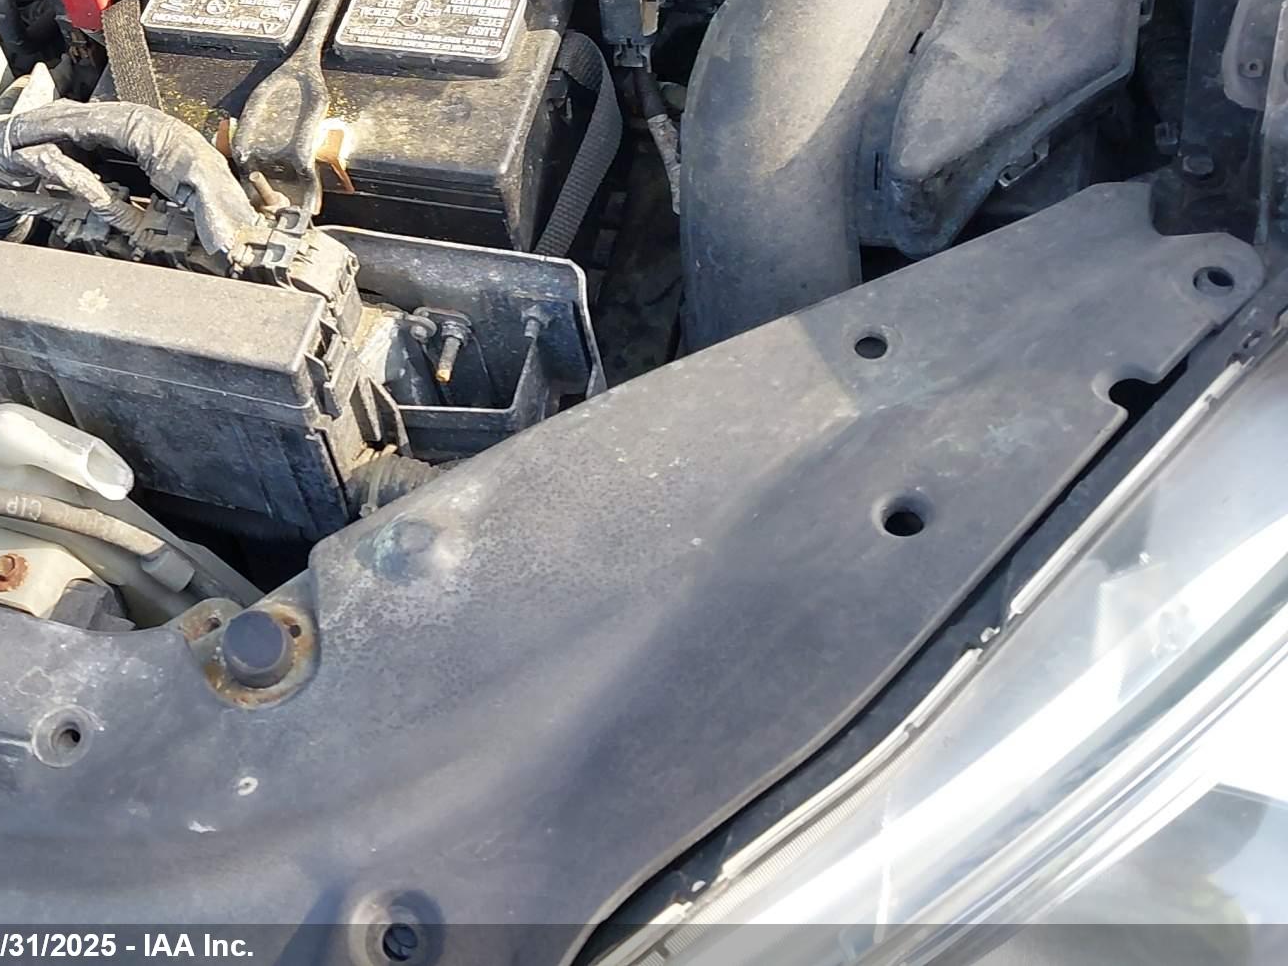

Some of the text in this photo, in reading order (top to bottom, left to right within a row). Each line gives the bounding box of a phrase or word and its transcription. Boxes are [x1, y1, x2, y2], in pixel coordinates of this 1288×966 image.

[444, 5, 509, 17] IMMEDIATELY
[476, 17, 505, 26] EYES
[466, 26, 501, 37] FLUSH
